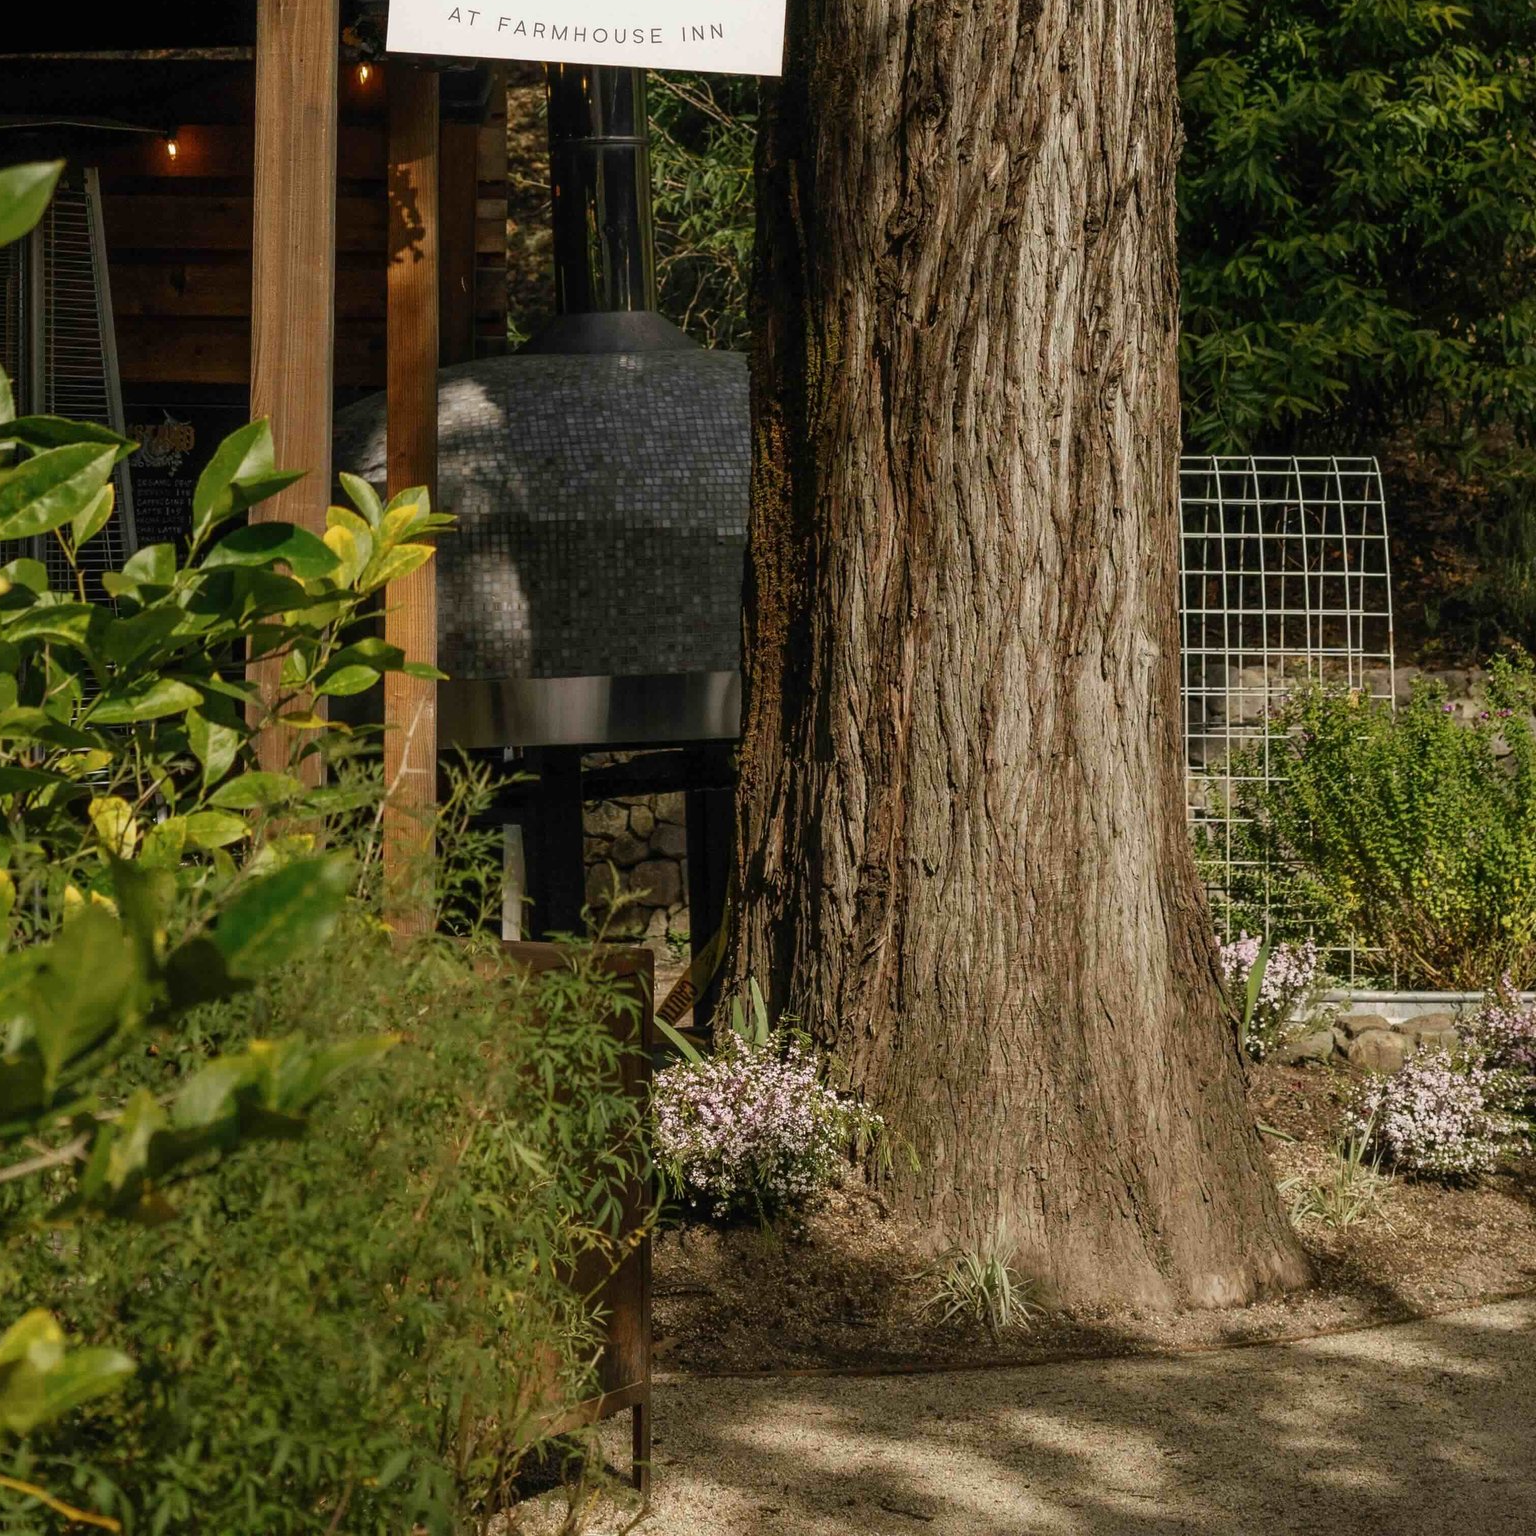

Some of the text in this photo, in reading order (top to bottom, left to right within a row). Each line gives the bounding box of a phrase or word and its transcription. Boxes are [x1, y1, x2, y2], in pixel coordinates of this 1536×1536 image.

[448, 7, 724, 44] AT FARMHOUSE INN
[656, 980, 699, 1024] CAUTI
